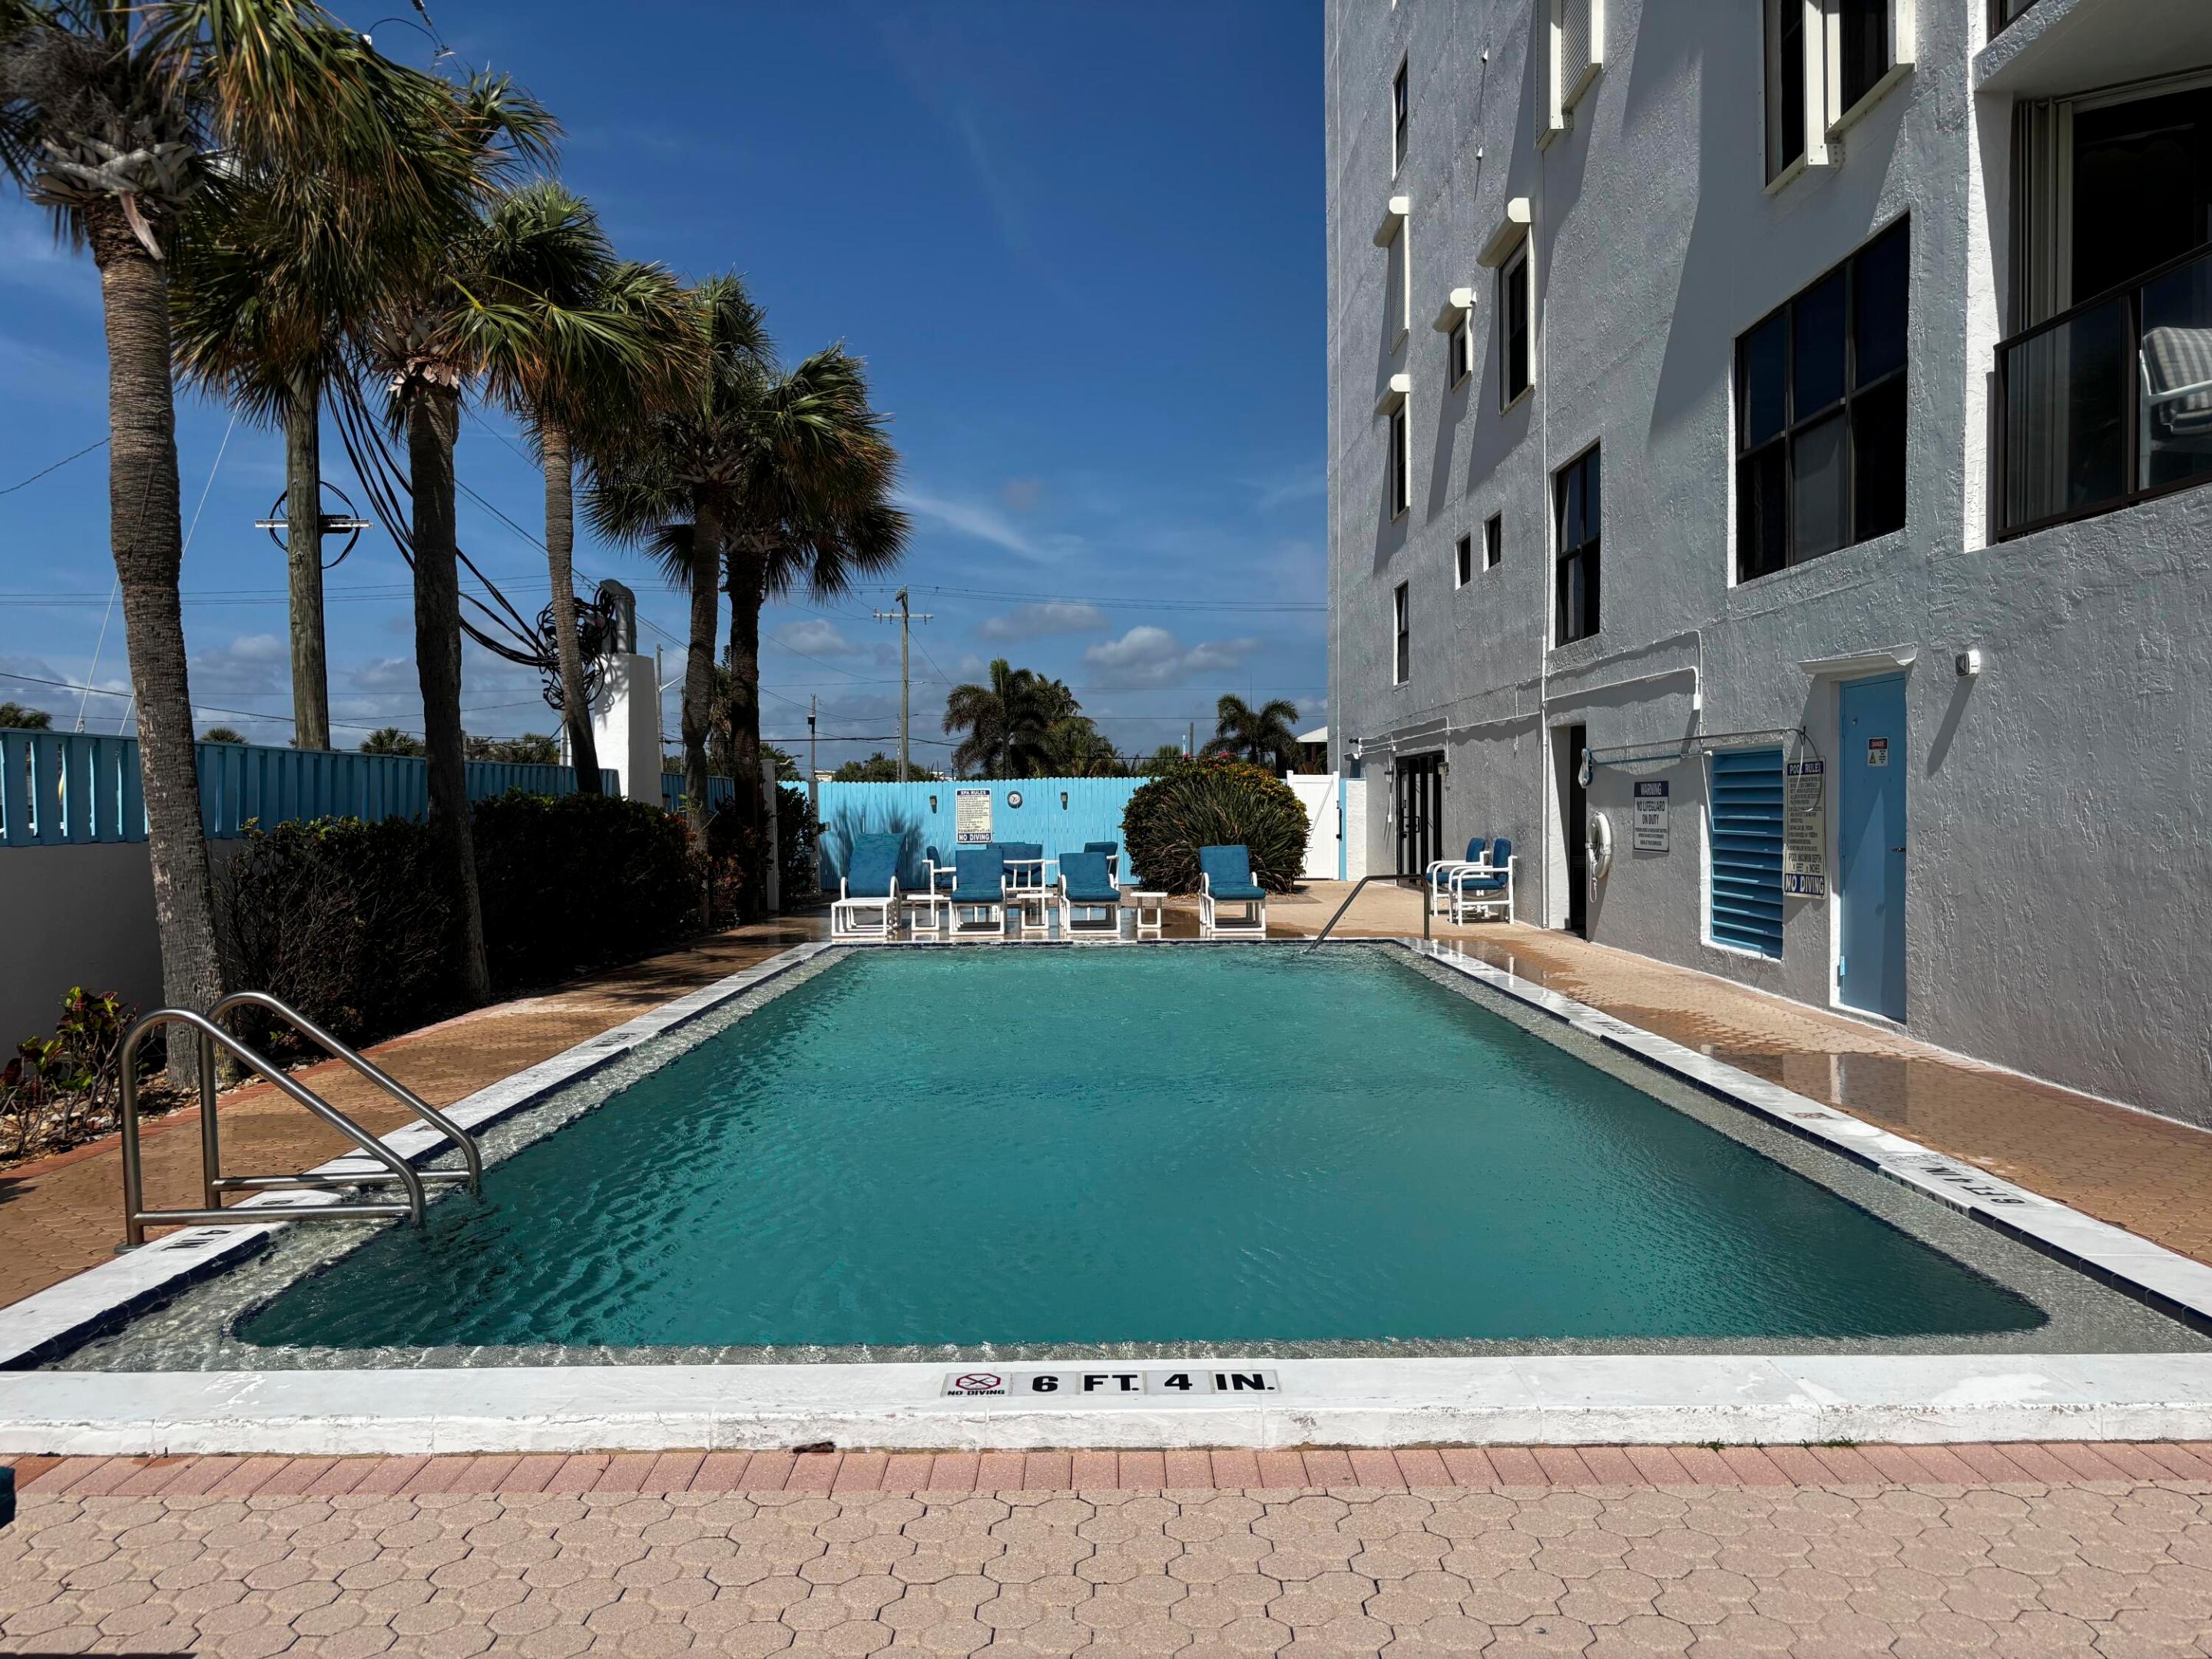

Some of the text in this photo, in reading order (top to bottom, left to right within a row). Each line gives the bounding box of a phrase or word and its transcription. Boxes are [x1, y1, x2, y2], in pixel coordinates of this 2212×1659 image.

[1641, 783, 1662, 796] WARNING
[1637, 801, 1666, 812] NO LIFEGUARD
[1642, 814, 1660, 825] ON DUTY
[1785, 875, 1824, 895] NO DIVING
[1032, 1374, 1274, 1392] 6 FT. 4 IN.
